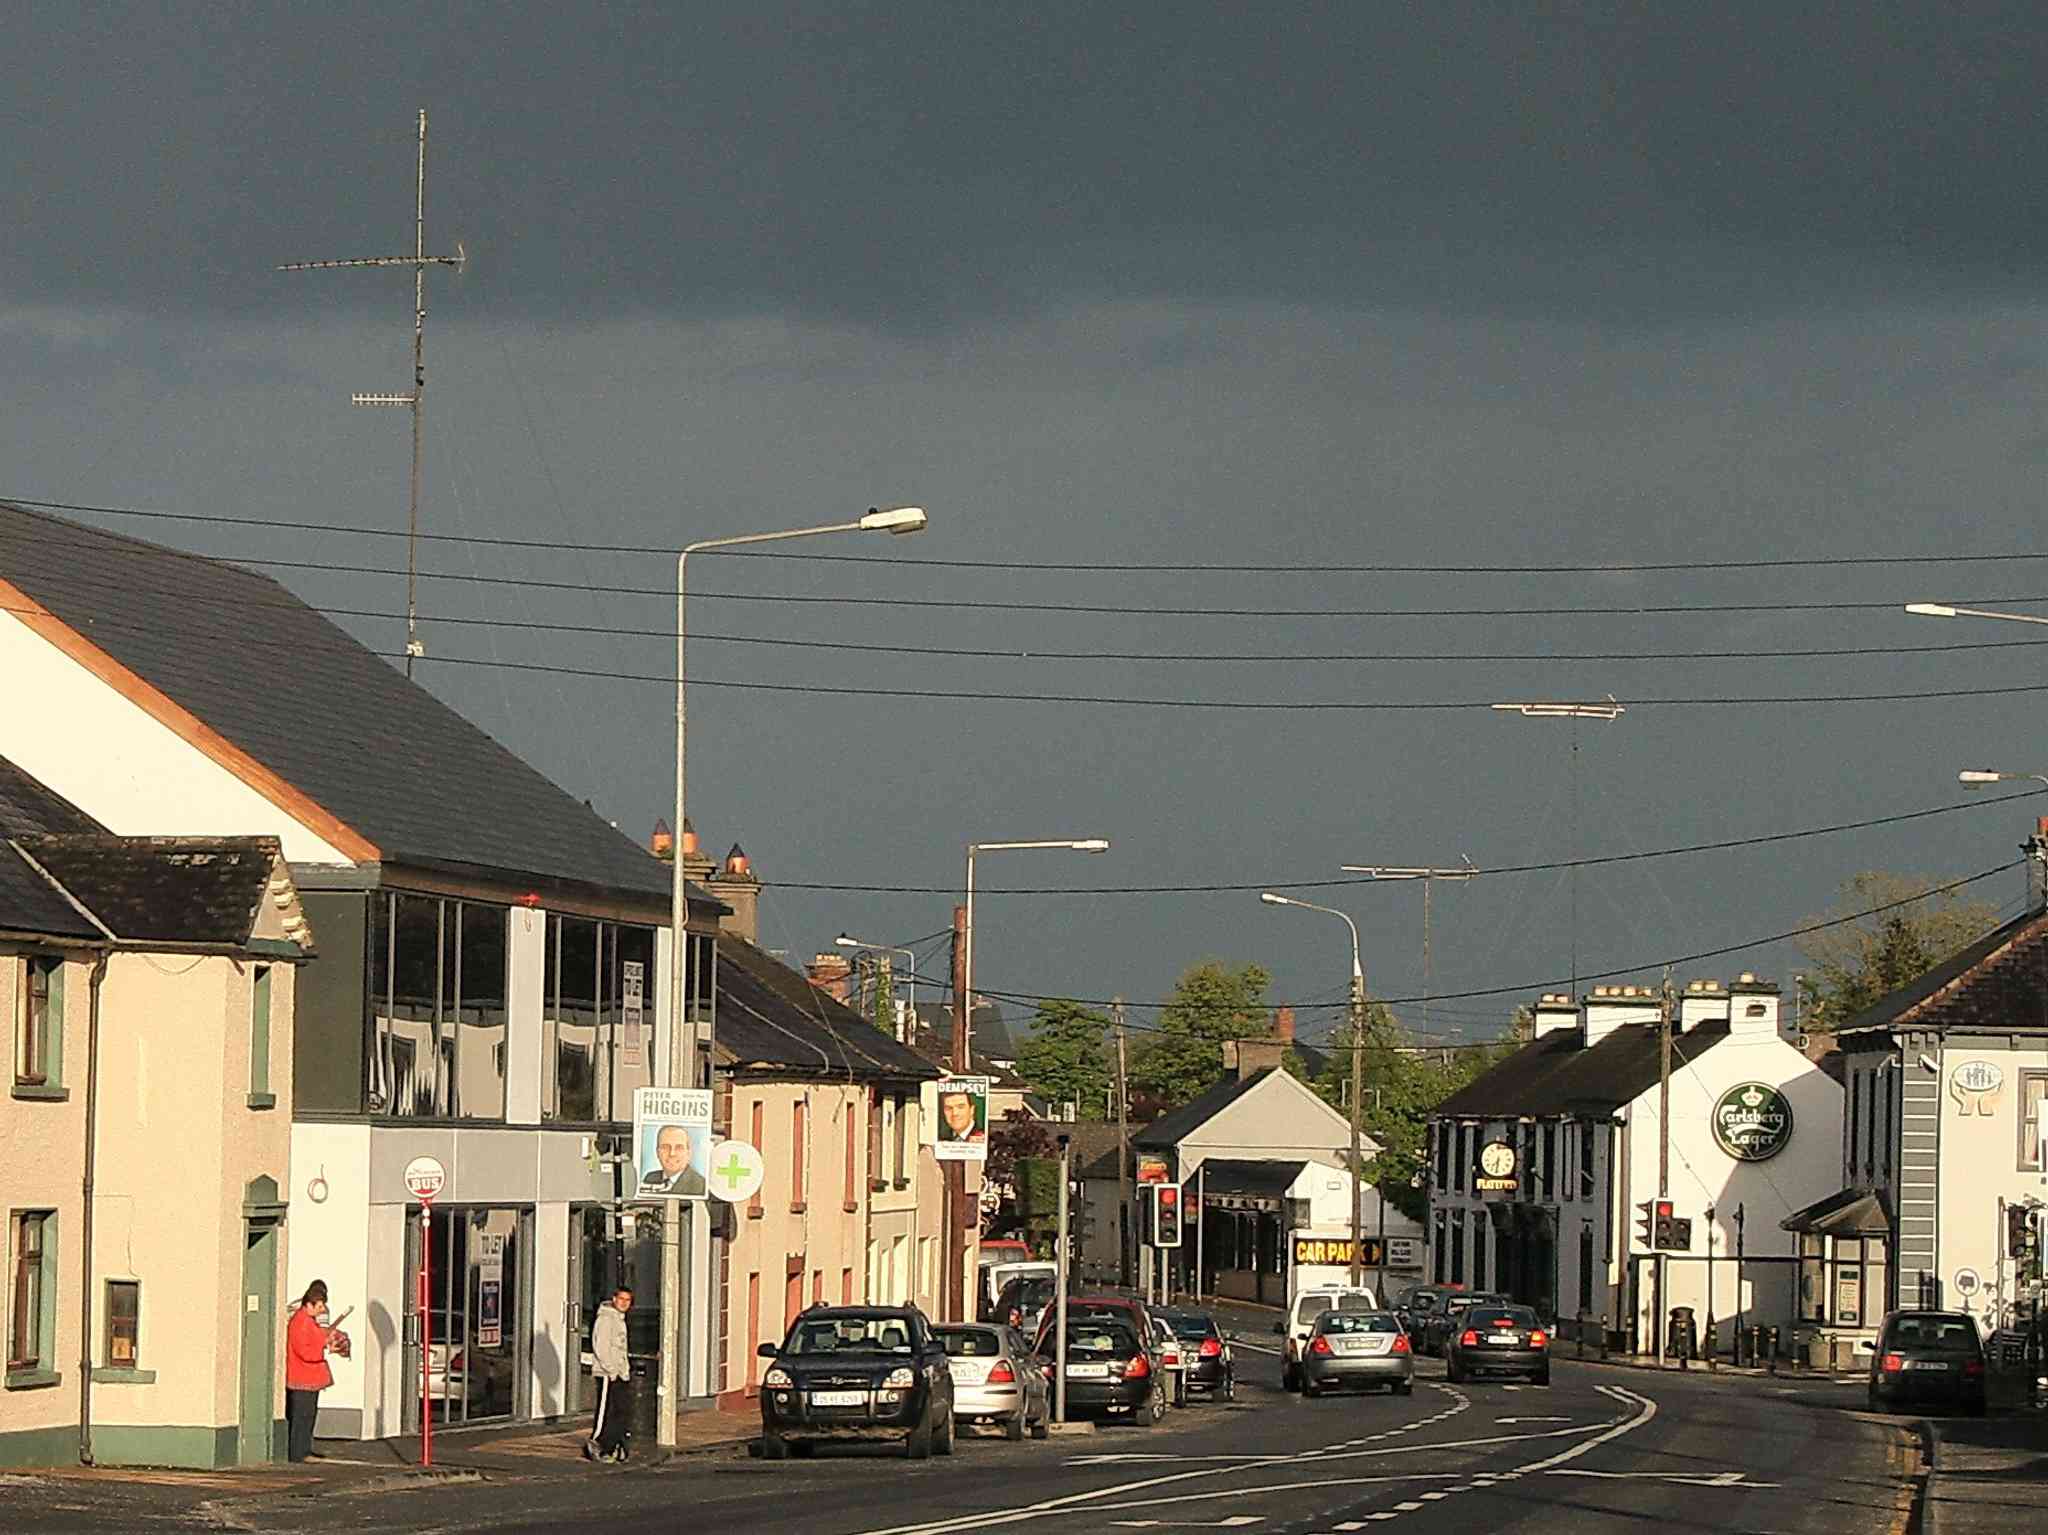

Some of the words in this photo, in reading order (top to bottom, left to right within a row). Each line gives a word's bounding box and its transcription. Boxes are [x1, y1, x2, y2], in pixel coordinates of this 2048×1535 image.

[938, 1082, 986, 1094] DEMPSEY
[643, 1100, 708, 1117] HIGGINS
[1719, 1105, 1784, 1132] Carlsberg
[1731, 1134, 1776, 1151] Lager
[411, 1177, 441, 1191] BUS
[1296, 1241, 1325, 1262] CAR
